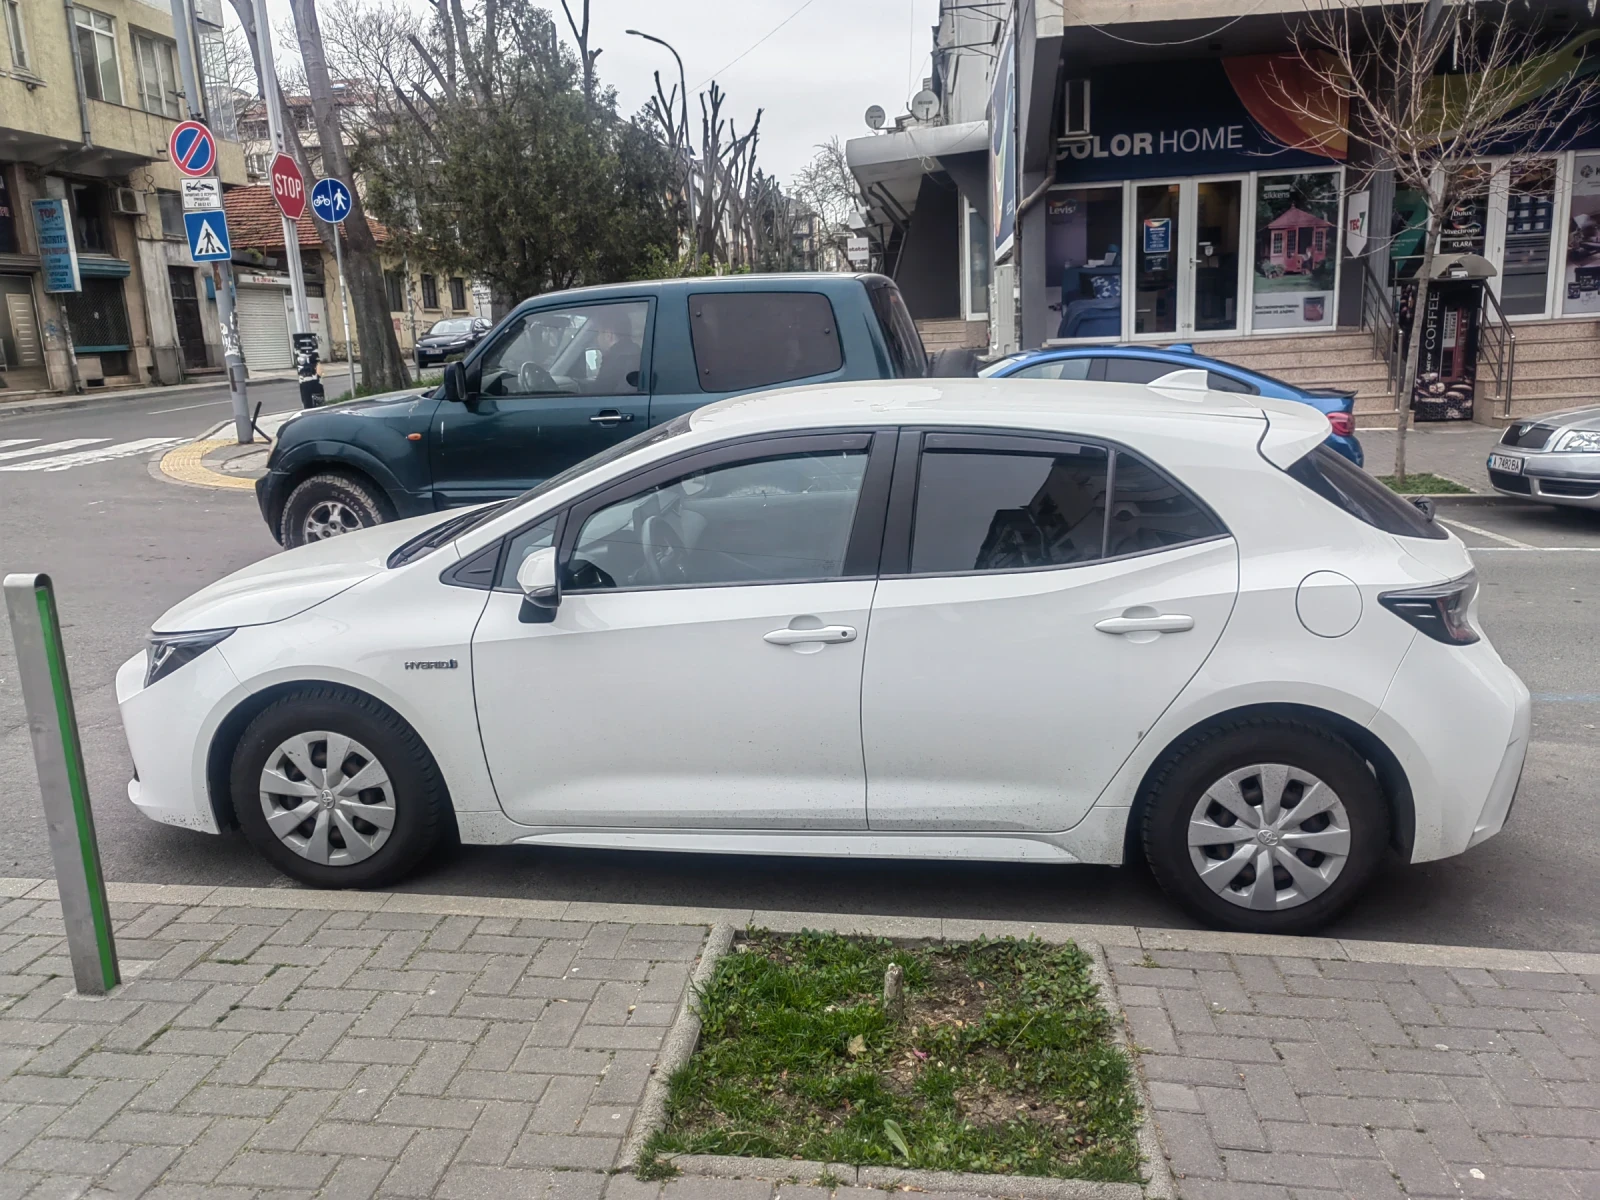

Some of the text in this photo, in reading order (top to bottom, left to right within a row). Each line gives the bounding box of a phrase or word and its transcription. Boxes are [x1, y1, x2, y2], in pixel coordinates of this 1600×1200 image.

[1159, 125, 1243, 154] HOME
[274, 172, 302, 200] STOP
[1263, 191, 1290, 199] sikkens
[1049, 205, 1073, 215] Levis
[1350, 211, 1366, 236] TEC7
[1425, 291, 1440, 350] COFFEE
[404, 661, 449, 670] HYBRID
